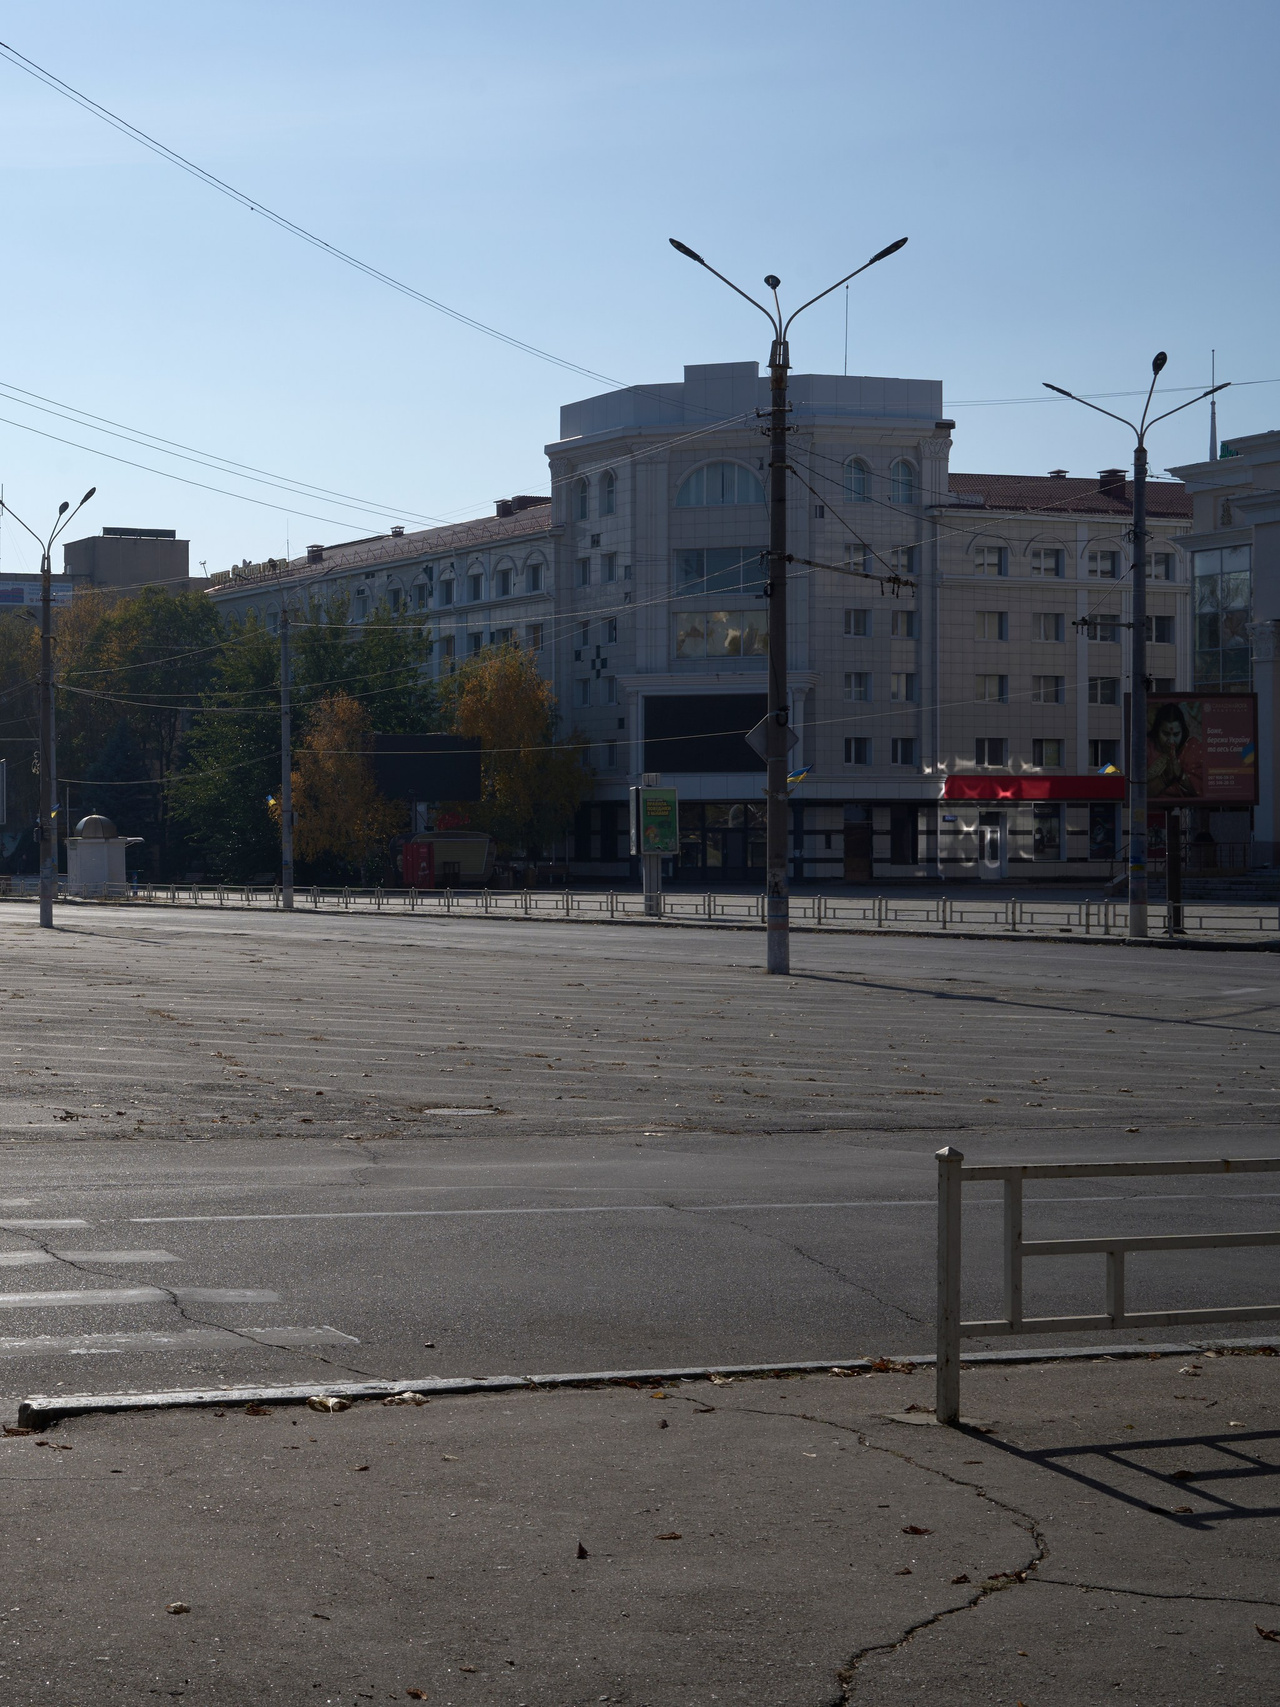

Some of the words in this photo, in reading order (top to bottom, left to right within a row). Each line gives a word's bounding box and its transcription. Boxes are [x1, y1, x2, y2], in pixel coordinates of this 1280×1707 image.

[1207, 727, 1223, 735] Боже,
[1207, 736, 1228, 744] бережи
[1228, 735, 1251, 745] Україну
